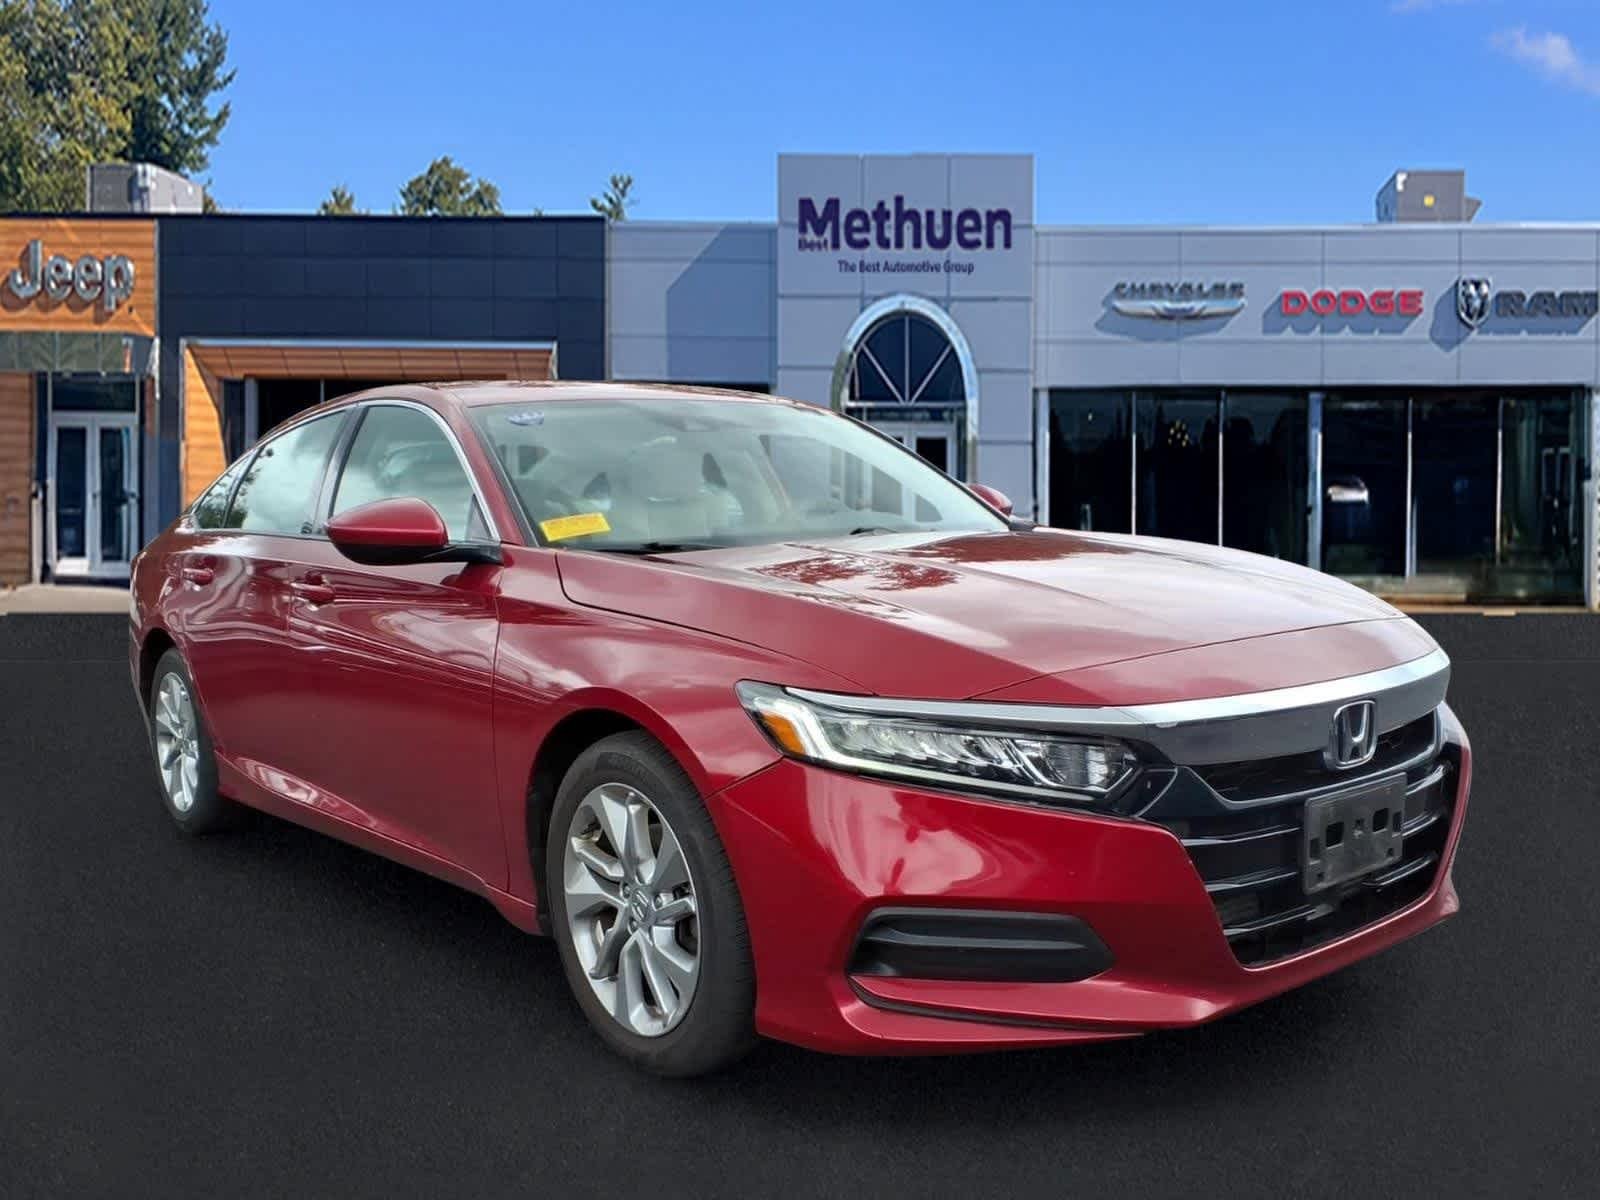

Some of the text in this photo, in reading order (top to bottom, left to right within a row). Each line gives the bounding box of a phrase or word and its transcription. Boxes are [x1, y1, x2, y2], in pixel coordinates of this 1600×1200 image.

[798, 195, 1012, 250] Methuen
[10, 240, 135, 311] Jeep
[838, 259, 975, 276] The Best Automotive Group
[1282, 290, 1424, 315] DODGE
[1495, 291, 1598, 317] RAM
